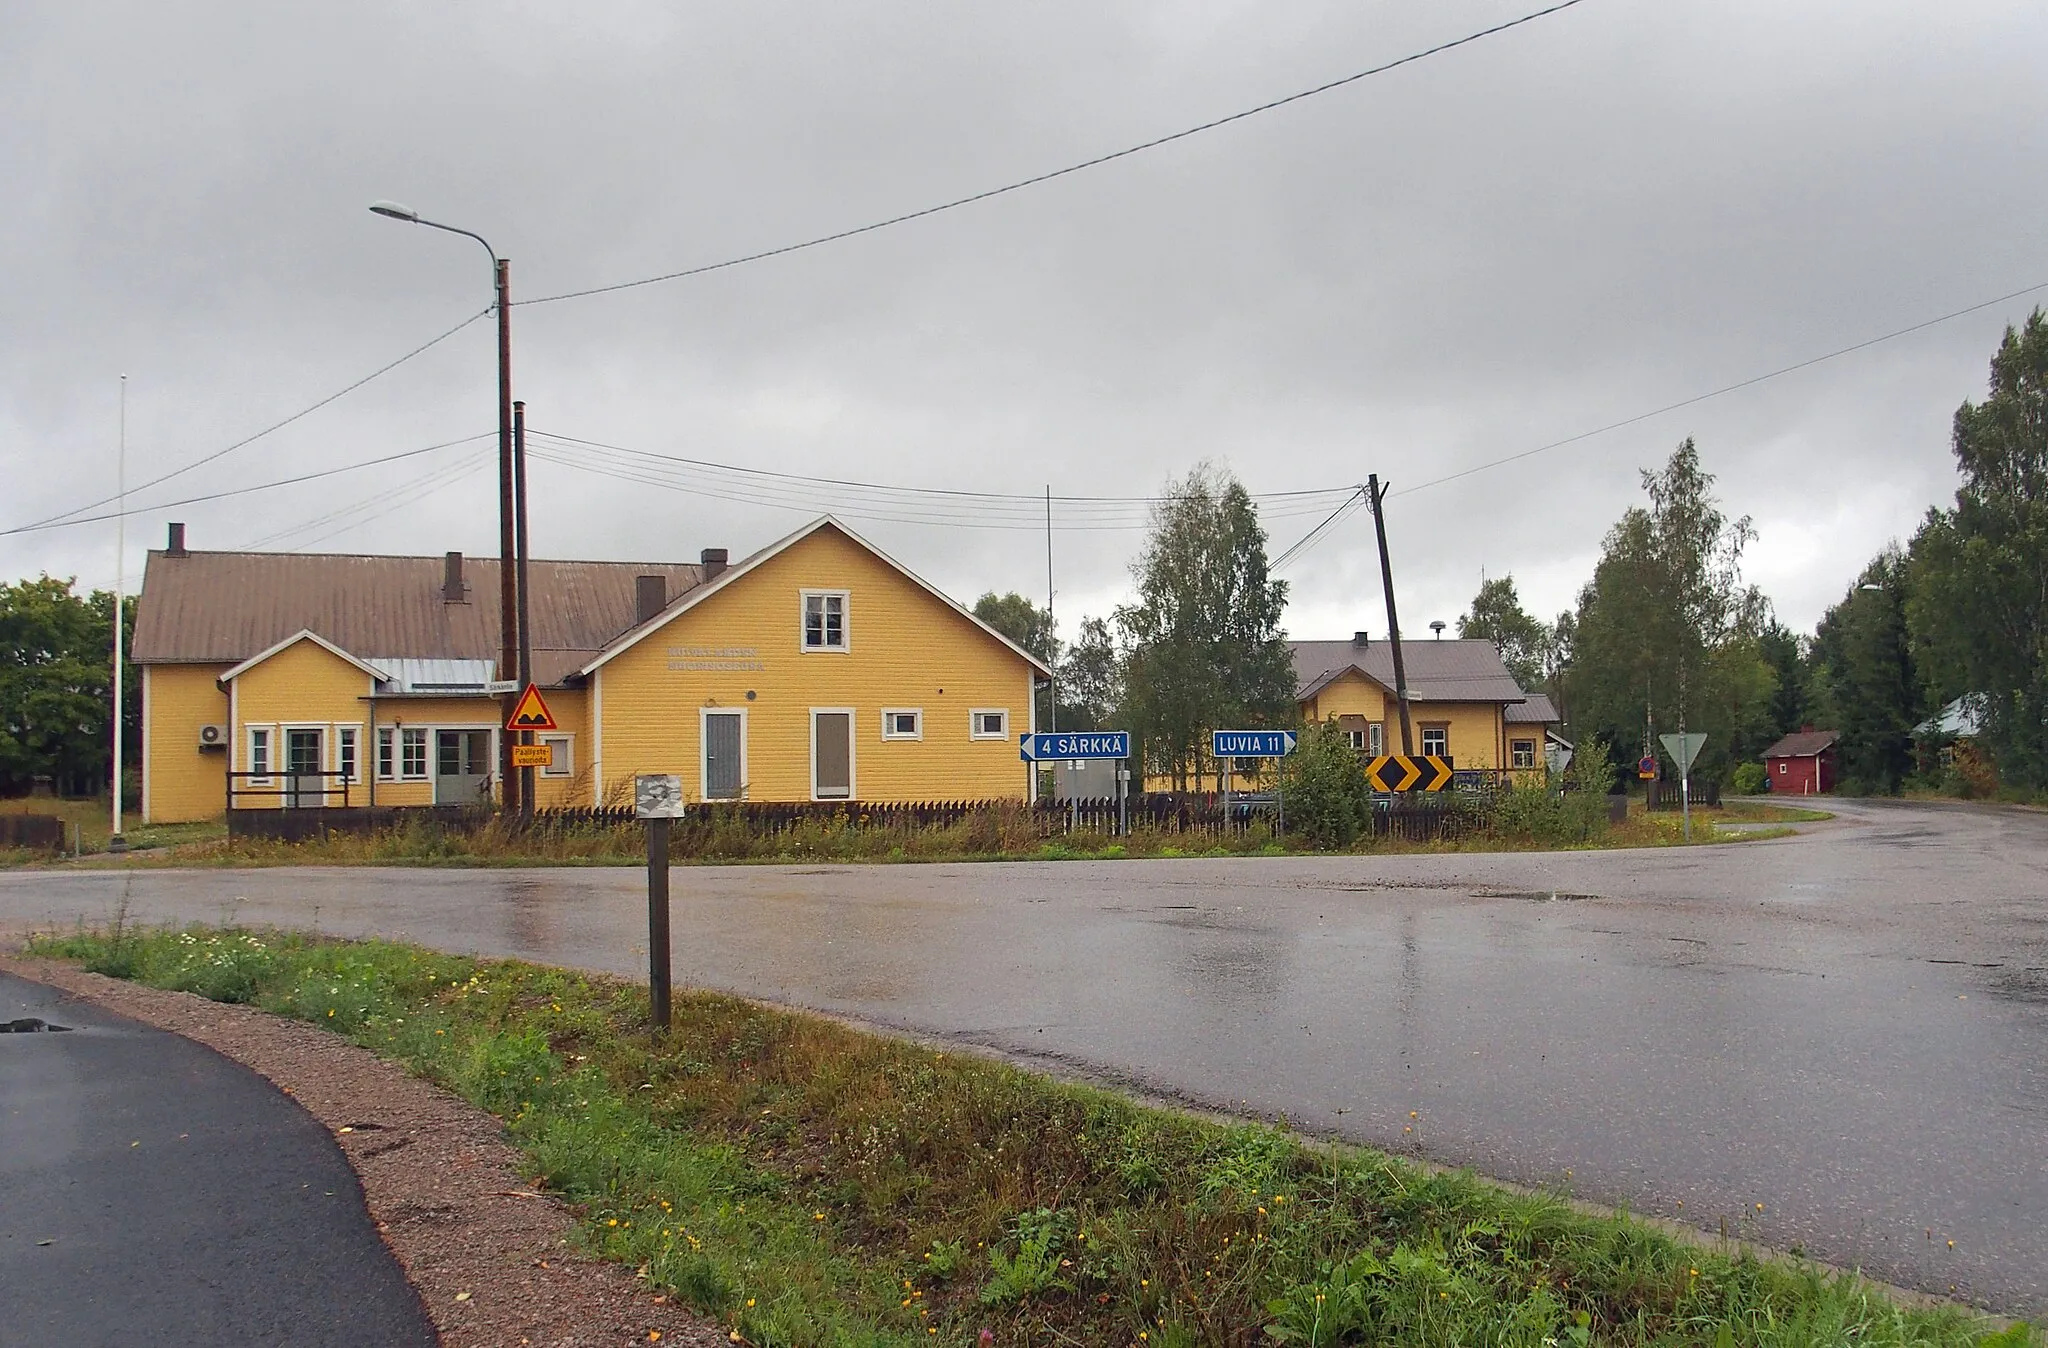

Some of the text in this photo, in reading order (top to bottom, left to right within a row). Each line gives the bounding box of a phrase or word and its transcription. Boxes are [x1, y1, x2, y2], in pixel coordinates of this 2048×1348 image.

[1042, 735, 1122, 753] 4 SÄRKKÄ
[1220, 736, 1279, 752] LUVIA 11
